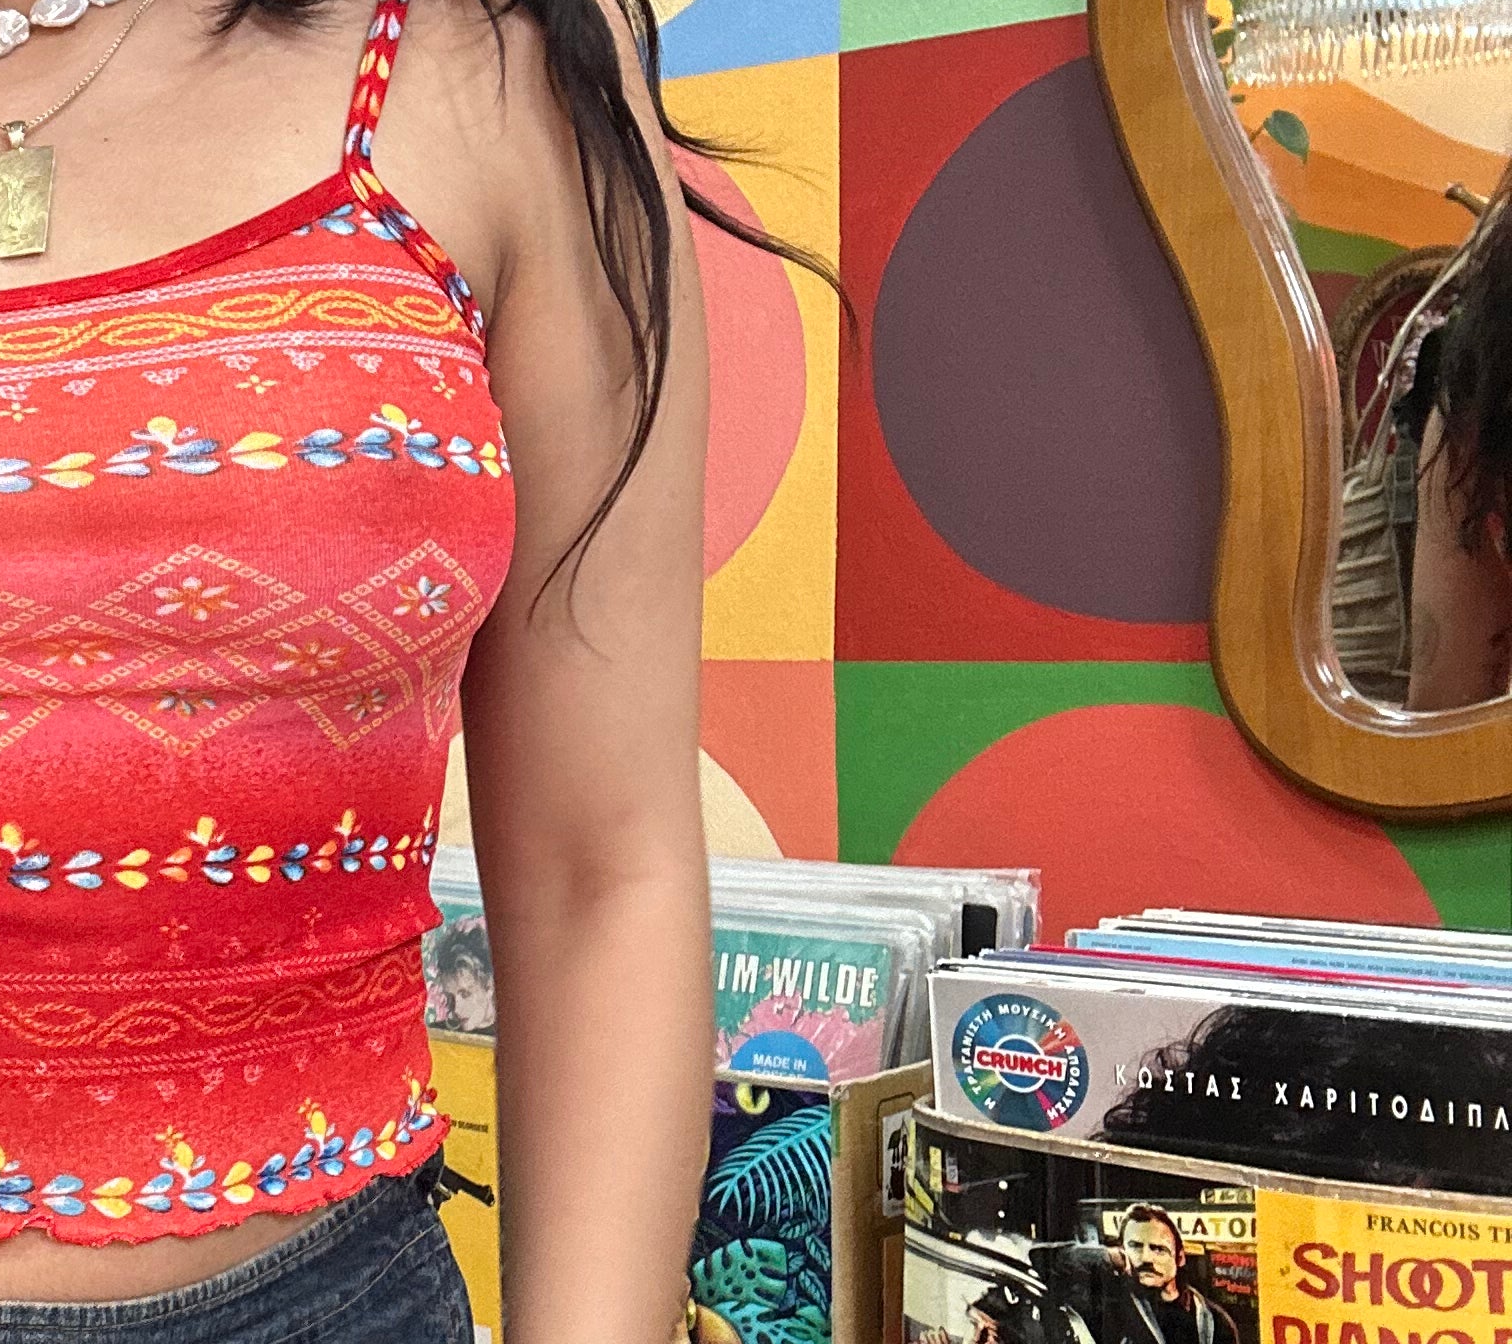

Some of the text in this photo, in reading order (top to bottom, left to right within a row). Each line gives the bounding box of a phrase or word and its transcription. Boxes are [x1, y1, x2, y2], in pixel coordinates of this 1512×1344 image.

[718, 952, 879, 1008] IM WILDE
[752, 1053, 808, 1072] MADE IN
[976, 1049, 1063, 1078] CRUNCH
[1114, 1062, 1243, 1102] ΚΩΣΤΑΣ
[1367, 1213, 1480, 1242] FRANCOIS
[1292, 1241, 1512, 1316] SHOOT
